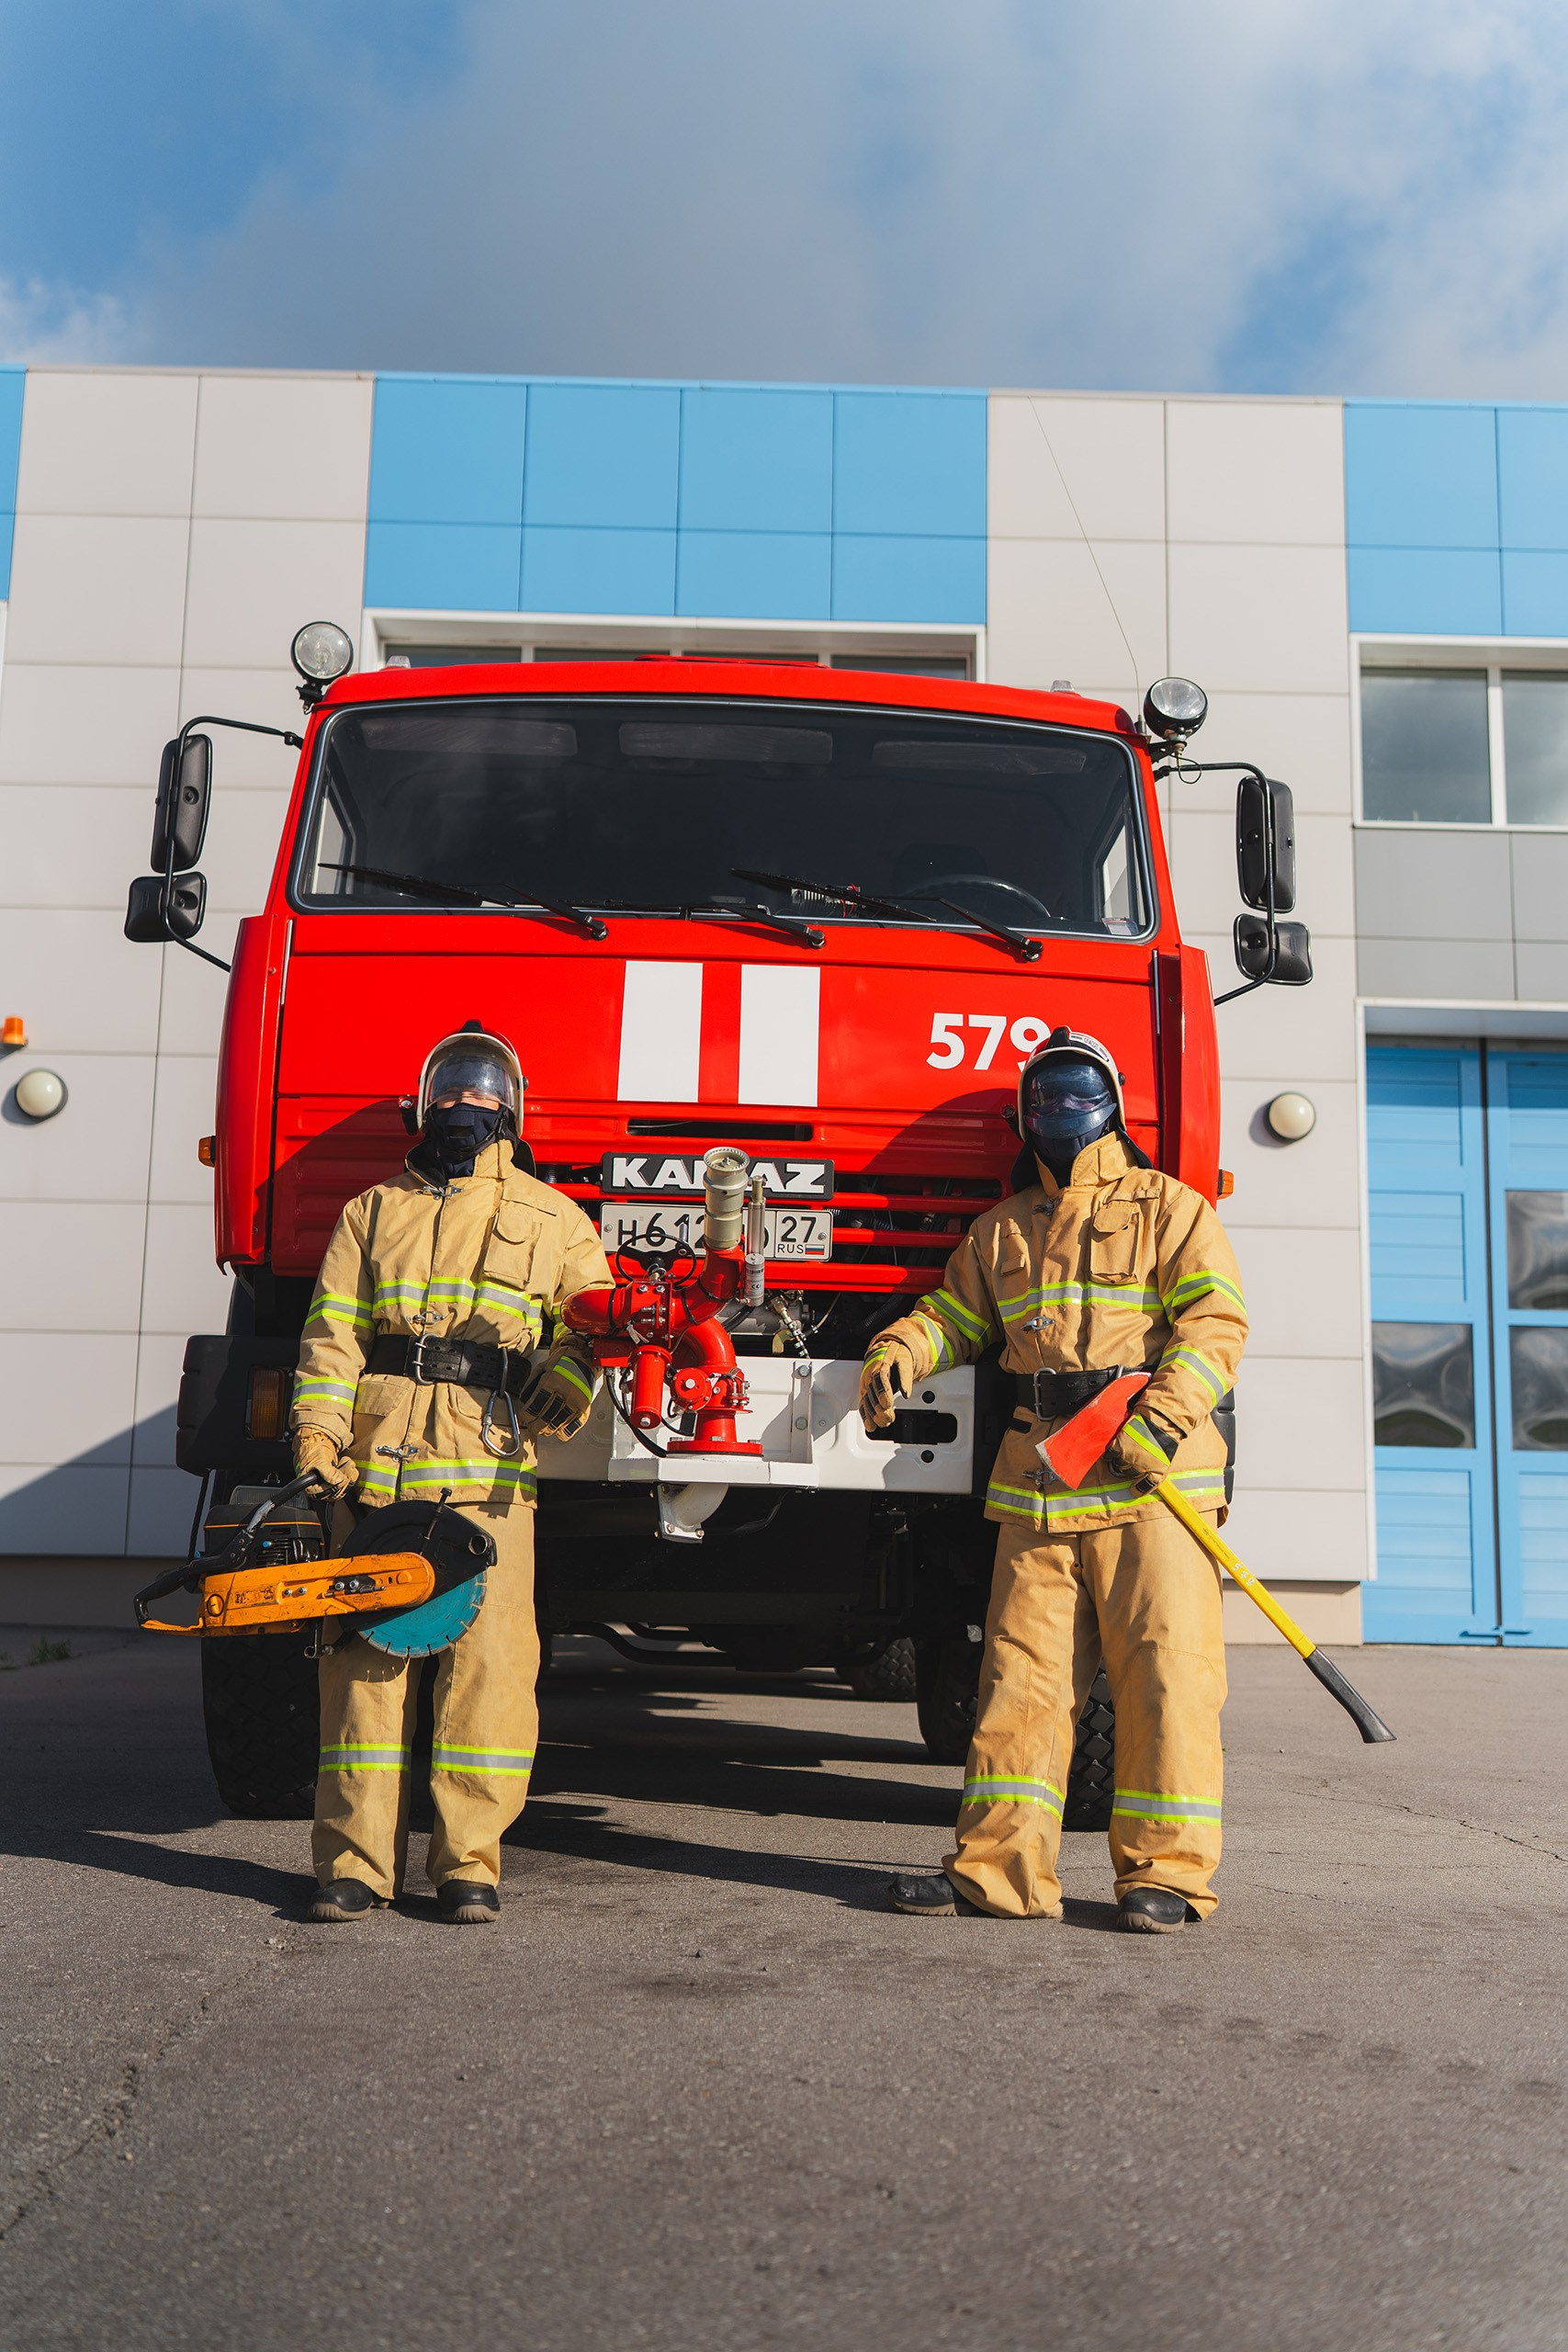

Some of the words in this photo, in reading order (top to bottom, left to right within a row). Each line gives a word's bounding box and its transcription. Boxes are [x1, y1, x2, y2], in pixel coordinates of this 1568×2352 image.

[926, 1012, 1052, 1073] 579
[612, 1157, 825, 1193] KAAZ
[781, 1216, 817, 1243] 27
[777, 1244, 804, 1253] RUS
